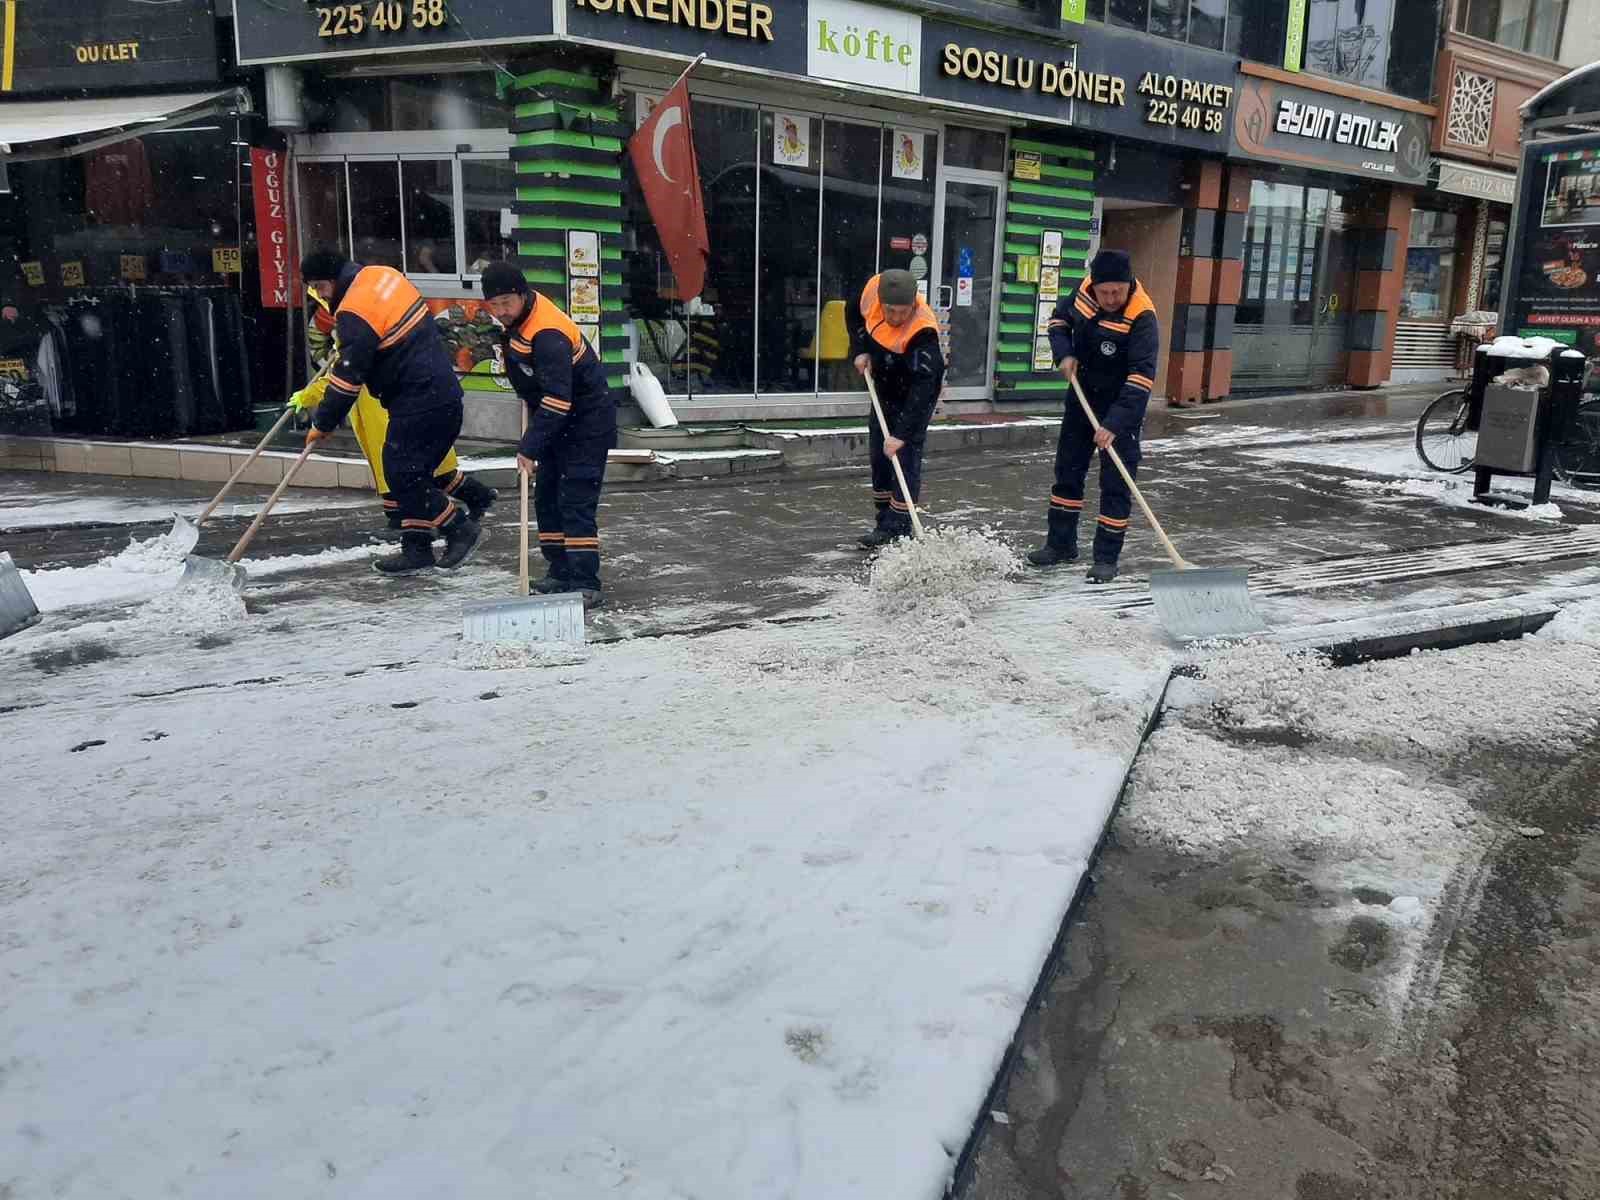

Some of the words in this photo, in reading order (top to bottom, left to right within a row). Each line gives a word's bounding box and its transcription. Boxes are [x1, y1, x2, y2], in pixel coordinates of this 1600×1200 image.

[318, 6, 364, 38] 225
[371, 2, 403, 32] 40
[411, 0, 445, 29] 58
[576, 0, 775, 42] ENDER
[816, 18, 913, 67] köfte
[943, 43, 1034, 90] SOSLU
[1041, 61, 1126, 106] DÖNER
[1139, 71, 1177, 99] ALO
[1180, 78, 1233, 108] PAKET
[1147, 99, 1178, 126] 225
[1180, 105, 1201, 130] 40
[1204, 110, 1223, 133] 58
[215, 250, 240, 262] 150
